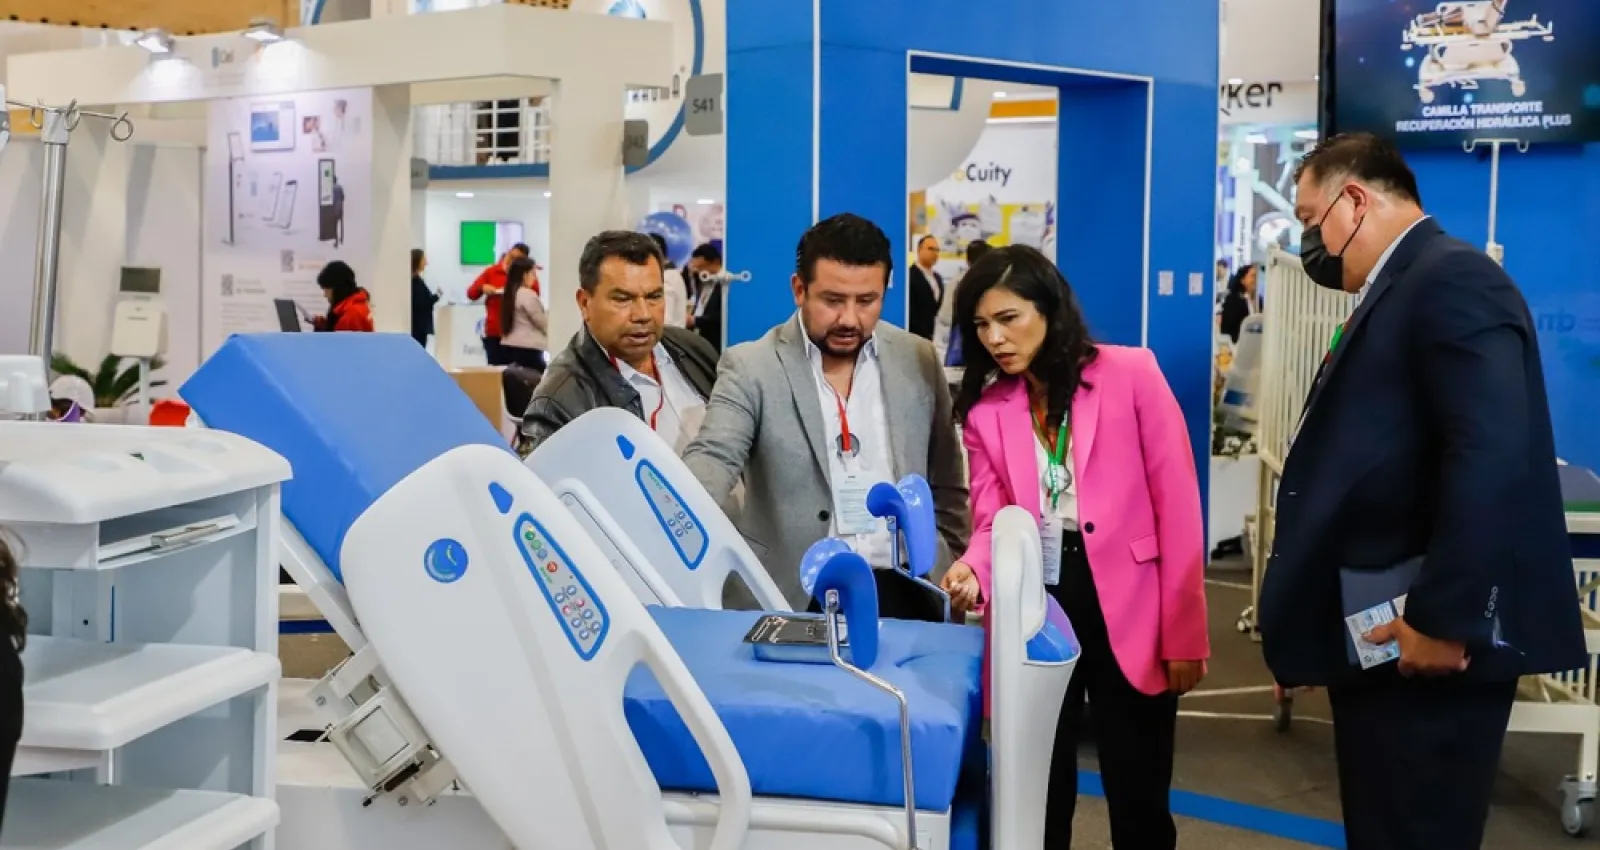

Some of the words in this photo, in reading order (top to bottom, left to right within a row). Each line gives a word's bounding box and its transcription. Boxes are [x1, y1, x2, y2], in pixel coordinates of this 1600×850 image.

[1220, 81, 1283, 116] ker
[1421, 104, 1468, 117] CAMILLA
[1469, 101, 1543, 115] TRANSPORTE
[1395, 117, 1475, 132] RECUPERACIÓN
[1476, 115, 1540, 129] HIDRÁULICA
[1541, 114, 1572, 129] PLUS
[953, 161, 1013, 187] oCuity
